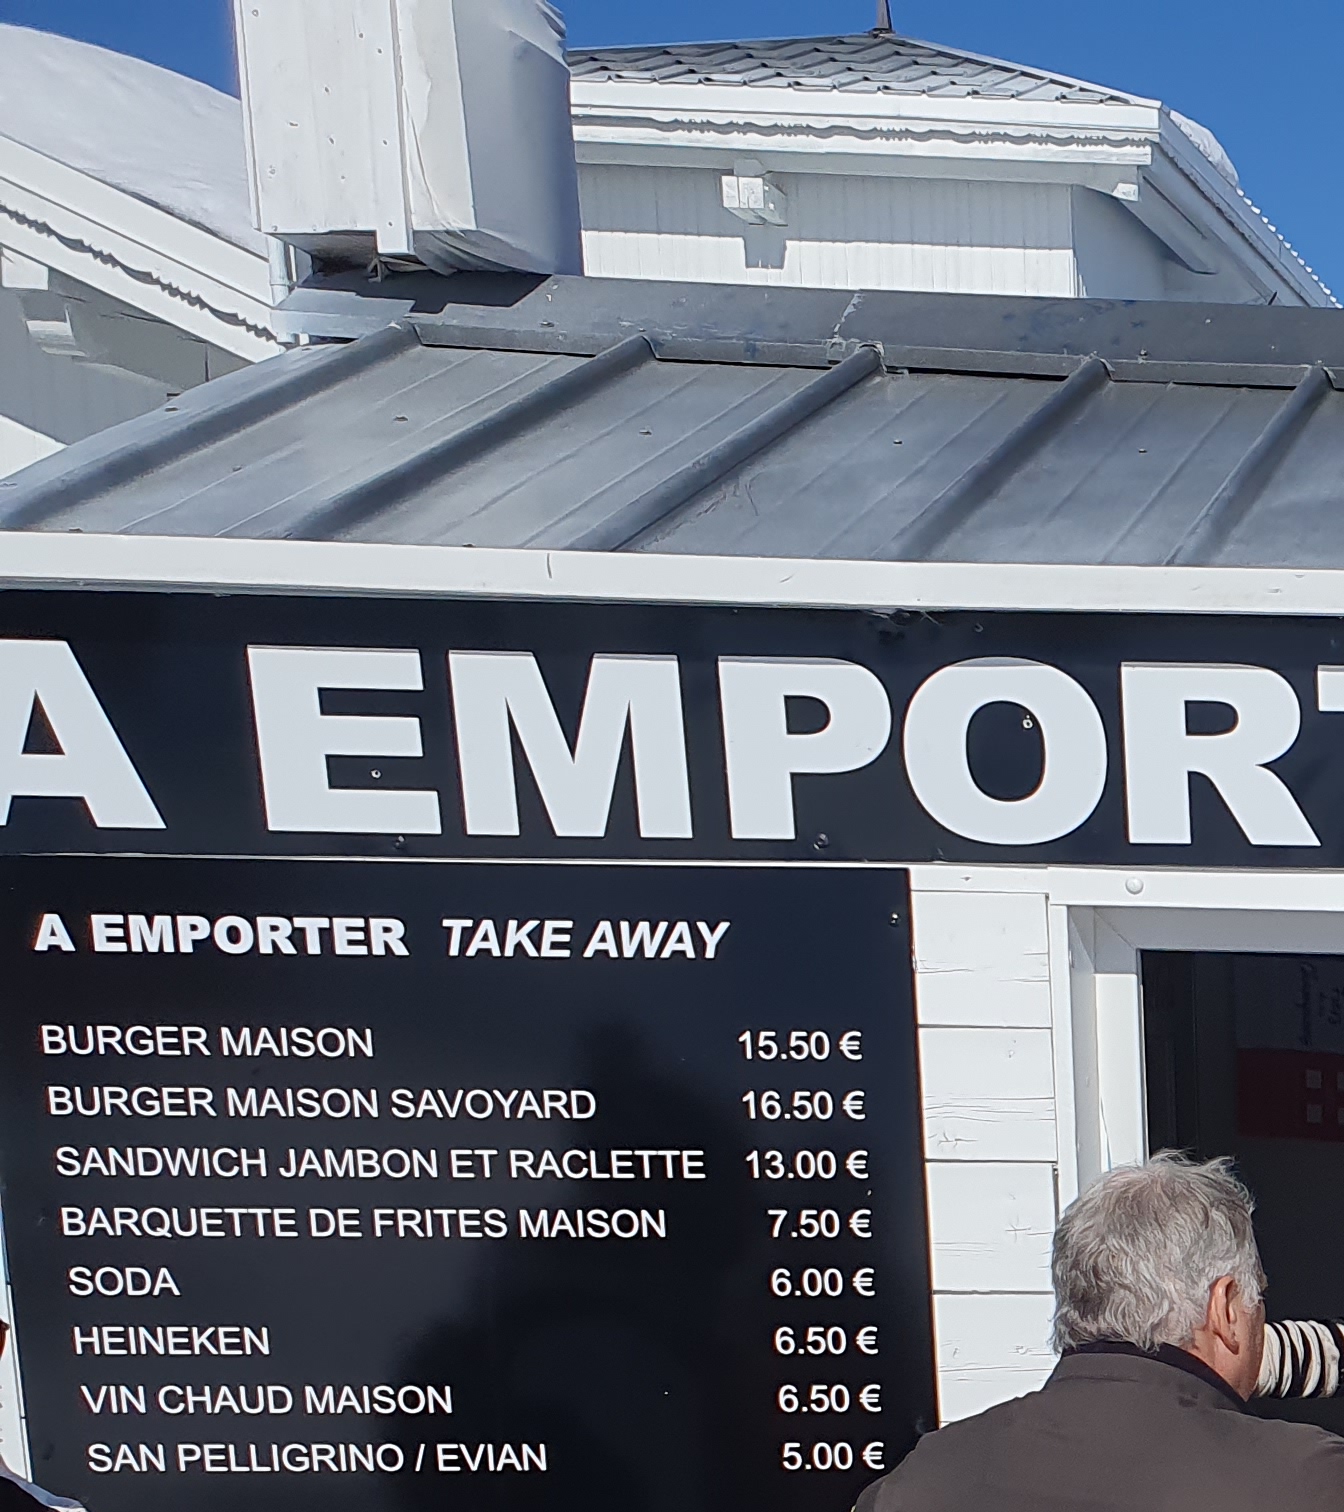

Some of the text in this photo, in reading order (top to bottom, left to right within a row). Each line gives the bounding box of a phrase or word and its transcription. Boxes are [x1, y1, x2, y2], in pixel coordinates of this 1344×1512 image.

[0, 638, 165, 832] A
[34, 913, 731, 959] A EMPORTER TAKE AWAY
[41, 1024, 863, 1061] BURGER MAISON 15.50 €
[47, 1086, 866, 1120] BURGER MAISON SAVOYARD 16.50 €
[56, 1146, 869, 1179] SANDWICH JAMBON ET RACLETTE 13.00 €
[60, 1207, 872, 1238] BARQUETTE DE FRITES MAISON 7.50 €
[69, 1266, 876, 1297] SODA 6.00 €
[73, 1325, 879, 1355] HEINEKEN 6.50 €
[80, 1383, 882, 1414] VIN CHAUD MAISON 6.50 €
[88, 1443, 166, 1473] SAN
[177, 1443, 404, 1472] PELLIGRINO
[436, 1443, 547, 1472] EVIAN
[782, 1442, 853, 1470] 5.00
[862, 1441, 885, 1470] €
